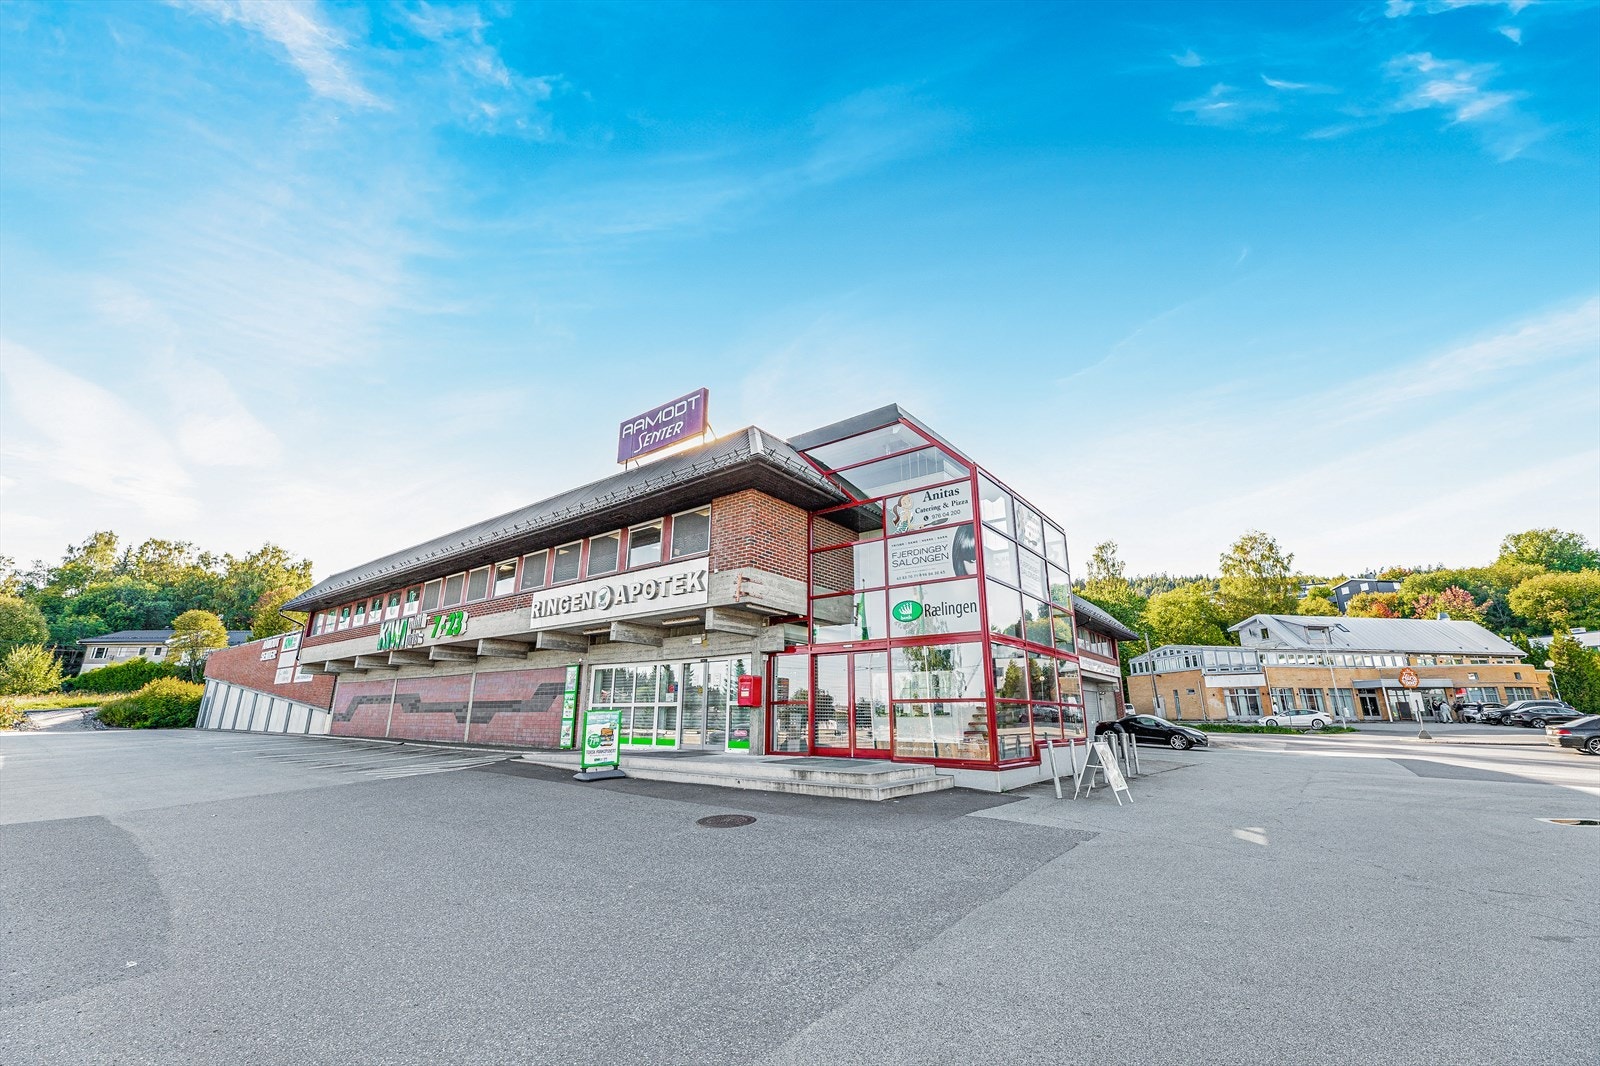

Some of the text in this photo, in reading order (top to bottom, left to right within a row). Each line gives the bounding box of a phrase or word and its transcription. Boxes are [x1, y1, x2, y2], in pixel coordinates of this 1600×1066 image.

[622, 394, 701, 438] AAMODT
[633, 421, 684, 453] SENTER
[923, 488, 960, 502] Anitas
[915, 505, 941, 514] Catering
[891, 544, 949, 559] FJERDINGBY
[892, 553, 950, 568] SALONGEN
[531, 570, 707, 618] RINGEN APOTEK
[924, 601, 977, 618] Rælingen
[377, 617, 409, 651] KIWI
